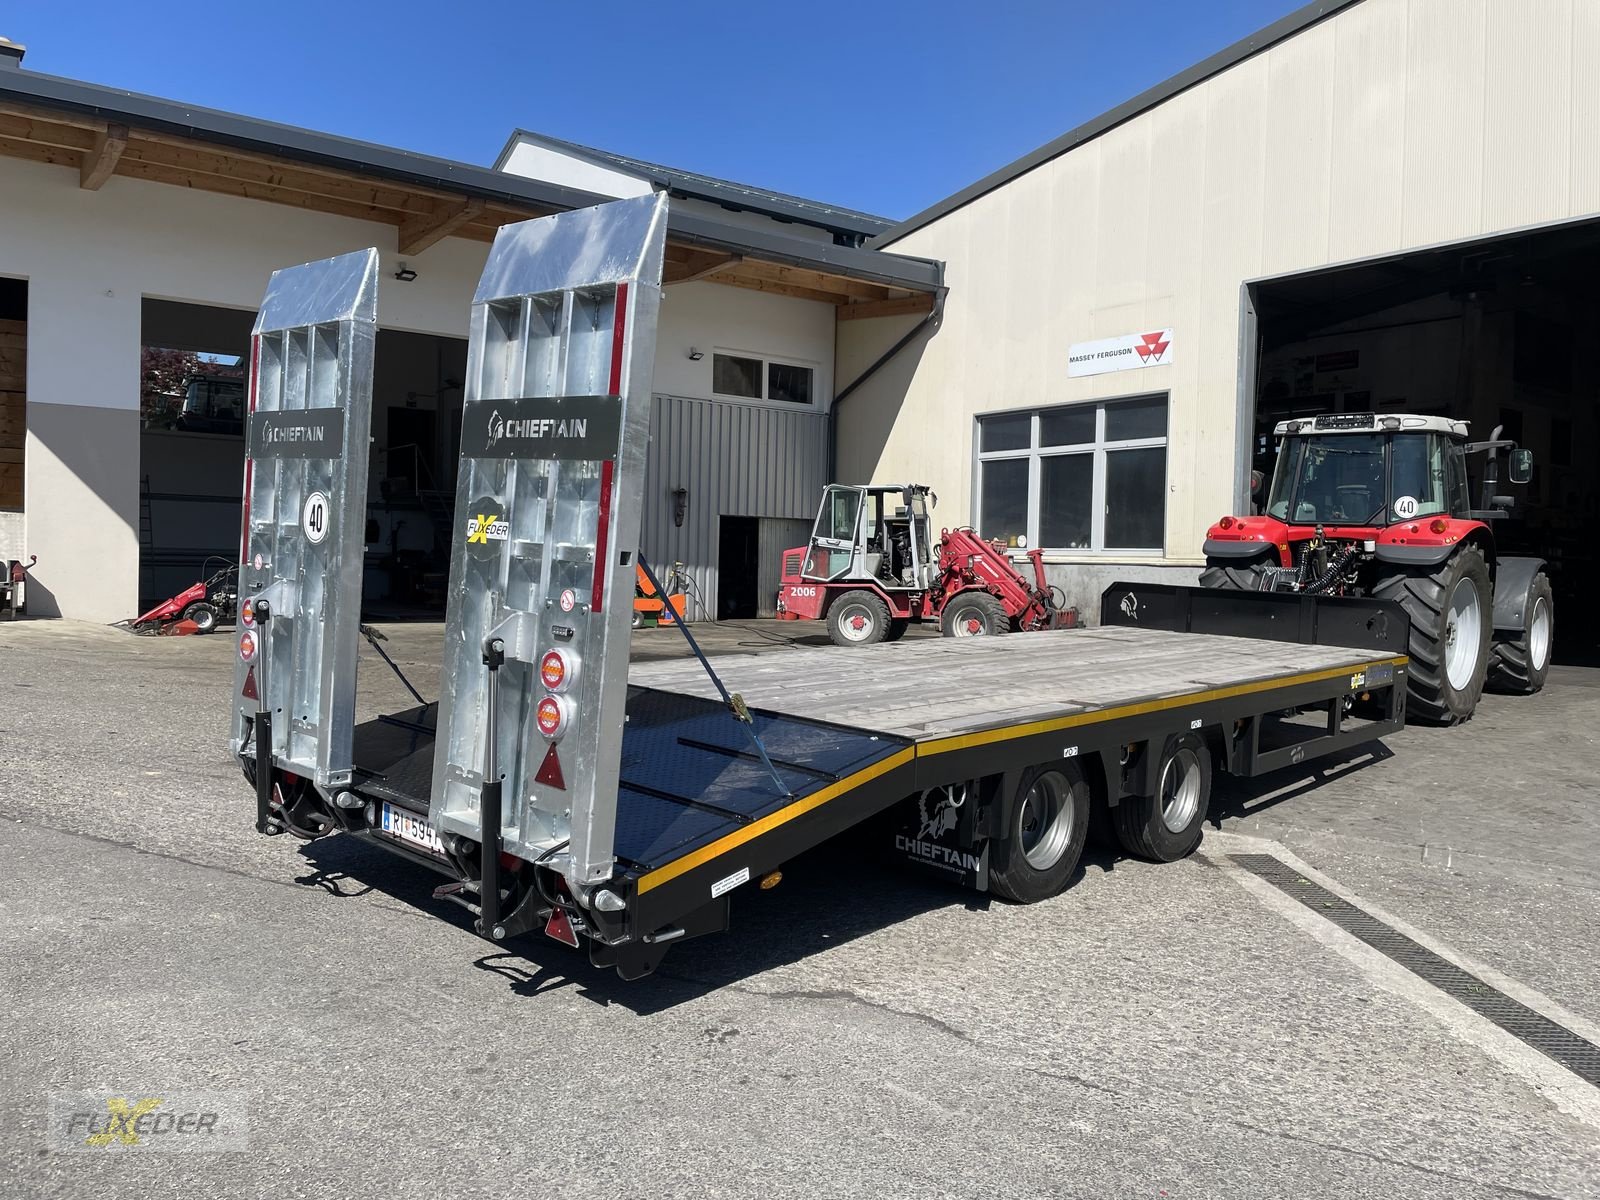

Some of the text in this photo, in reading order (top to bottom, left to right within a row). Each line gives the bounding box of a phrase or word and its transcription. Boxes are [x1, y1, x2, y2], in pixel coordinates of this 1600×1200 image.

[1069, 347, 1133, 364] MASSEY FERGUSON
[273, 425, 324, 442] CHIEFTAIN
[505, 418, 588, 438] CHIEFTAIN
[1399, 500, 1414, 514] 40
[309, 503, 323, 533] 40
[790, 586, 816, 597] 2006
[895, 834, 980, 872] CHIEFTAIN
